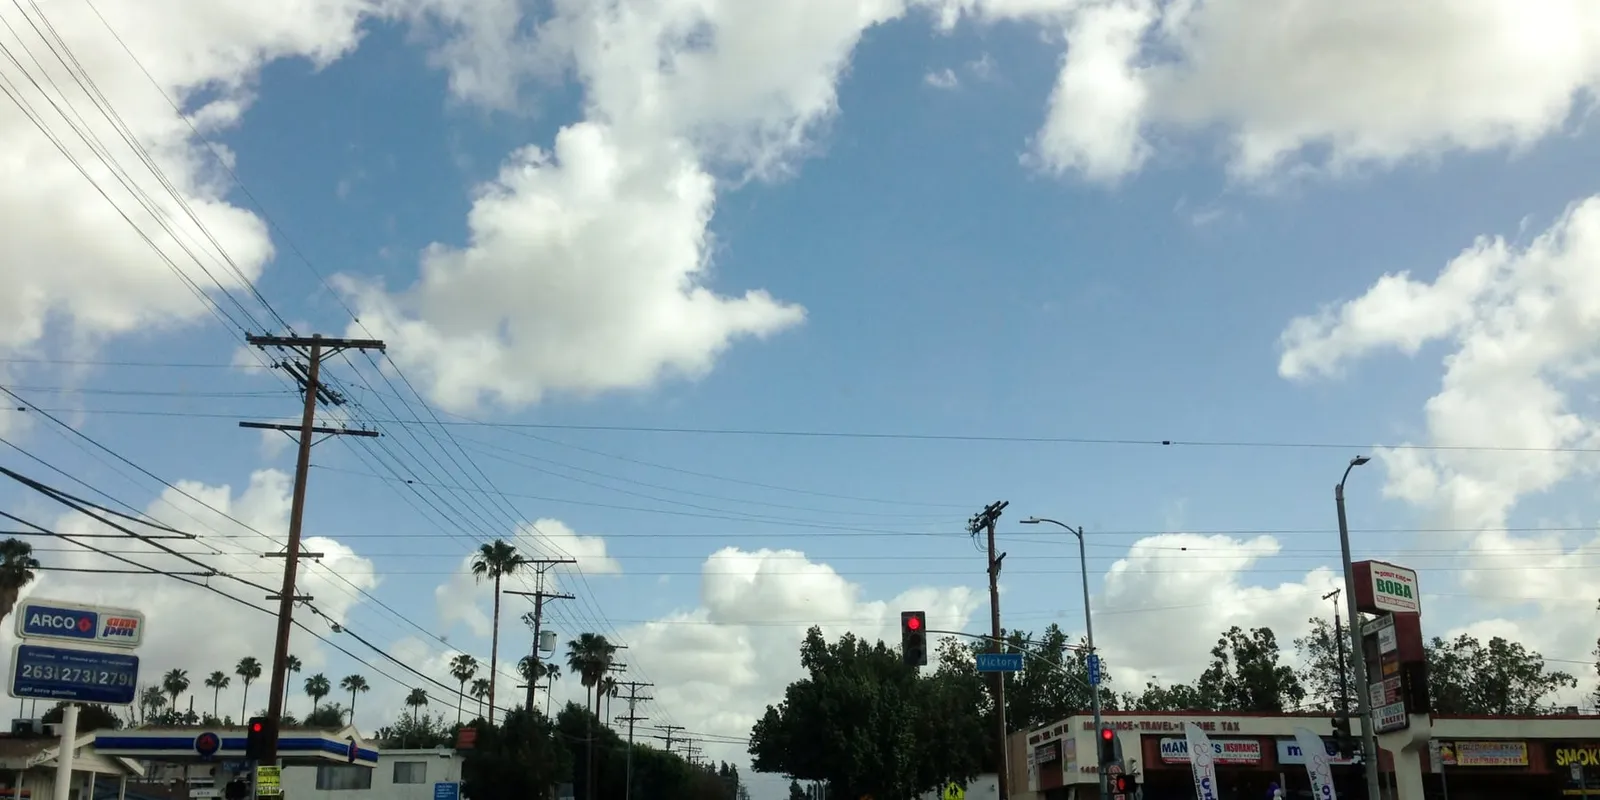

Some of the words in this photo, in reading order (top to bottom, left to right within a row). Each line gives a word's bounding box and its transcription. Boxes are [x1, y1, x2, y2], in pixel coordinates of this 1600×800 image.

[1376, 578, 1413, 599] BOBA
[30, 613, 75, 629] ARCO
[980, 657, 1018, 667] Victory
[1141, 721, 1174, 731] TRAVEL
[1221, 721, 1240, 731] TAX
[1224, 743, 1259, 753] INSURANCE
